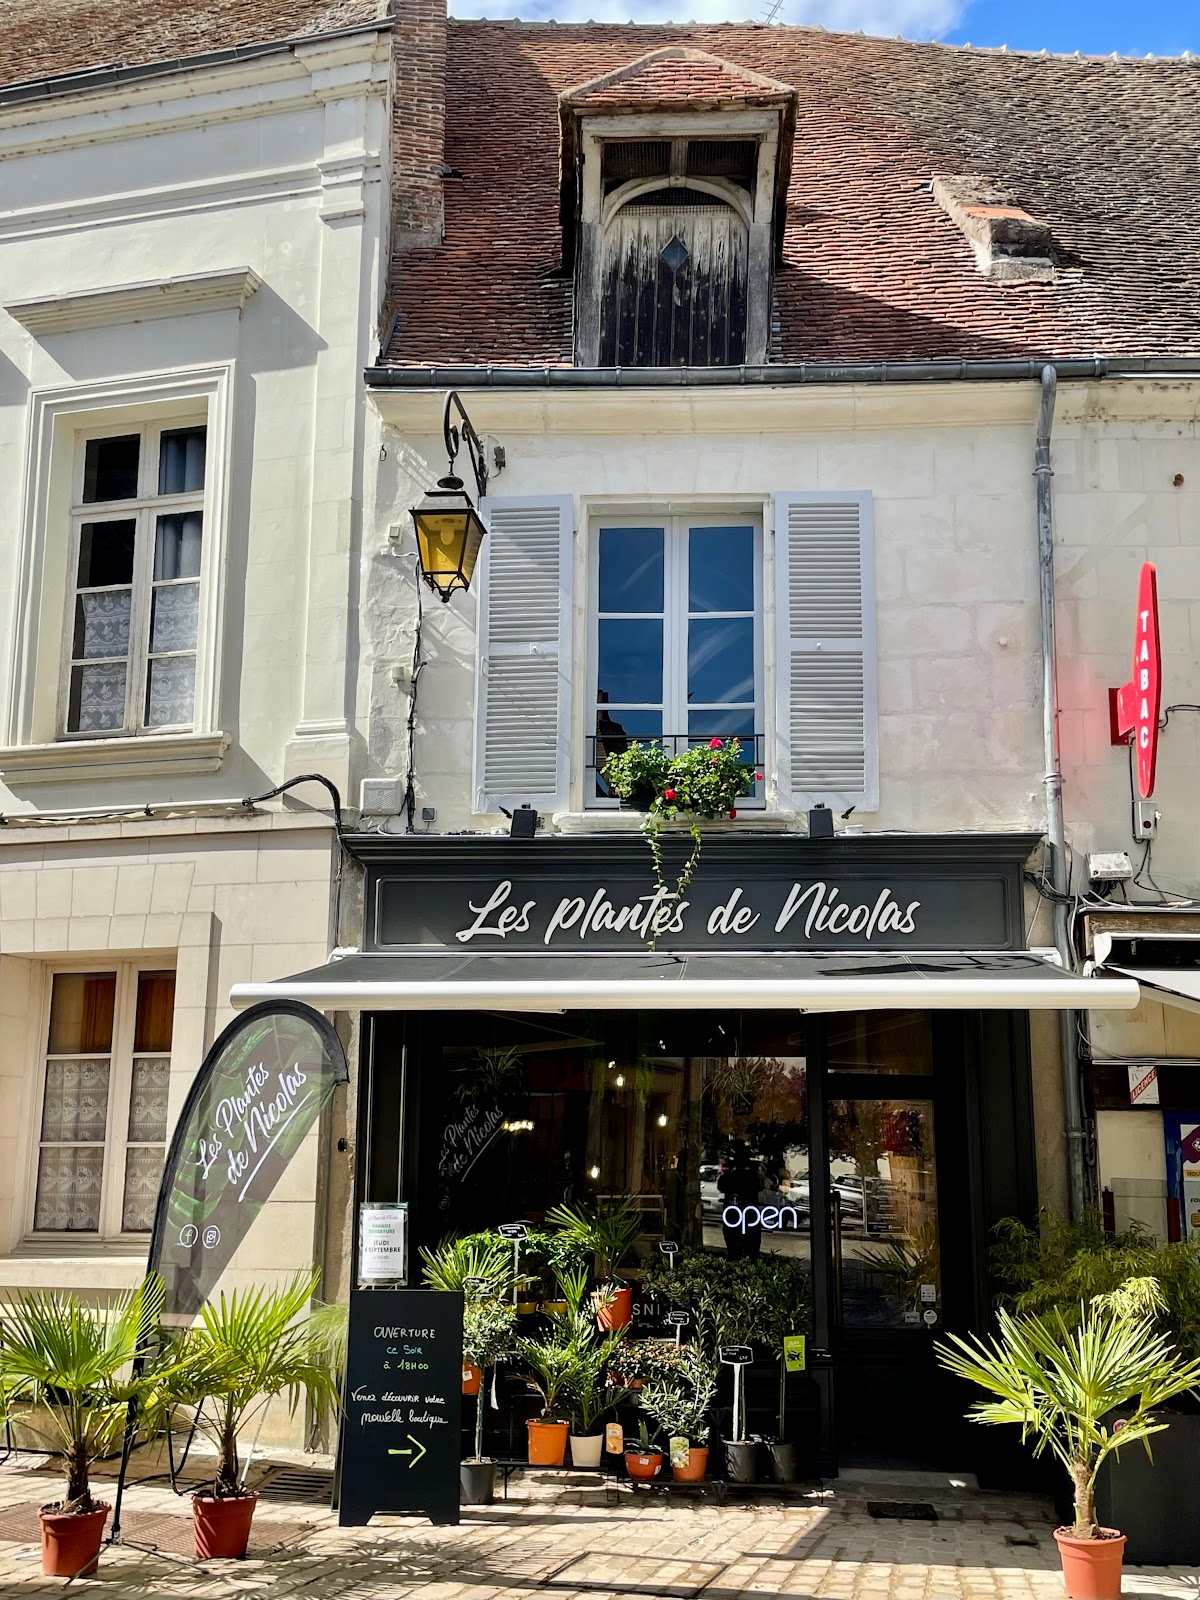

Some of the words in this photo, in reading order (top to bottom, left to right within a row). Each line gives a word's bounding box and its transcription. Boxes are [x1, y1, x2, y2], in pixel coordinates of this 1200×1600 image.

[1140, 611, 1149, 749] TABAC
[455, 880, 536, 942] Les
[544, 886, 690, 945] plantes
[708, 888, 761, 935] de
[775, 881, 921, 940] Nicolas
[1131, 1069, 1156, 1100] LICENCE
[196, 1133, 223, 1180] Les
[215, 1061, 270, 1138] Plantes
[227, 1148, 250, 1184] de
[244, 1062, 307, 1153] Nicolas
[444, 1104, 480, 1148] Plantes
[463, 1104, 504, 1156] Nicolas
[722, 1205, 798, 1235] open
[373, 1326, 436, 1340] OUVERTURE
[383, 1360, 391, 1370] à
[350, 1384, 377, 1402] Venez
[425, 1394, 446, 1405] votre
[408, 1408, 449, 1429] boutique
